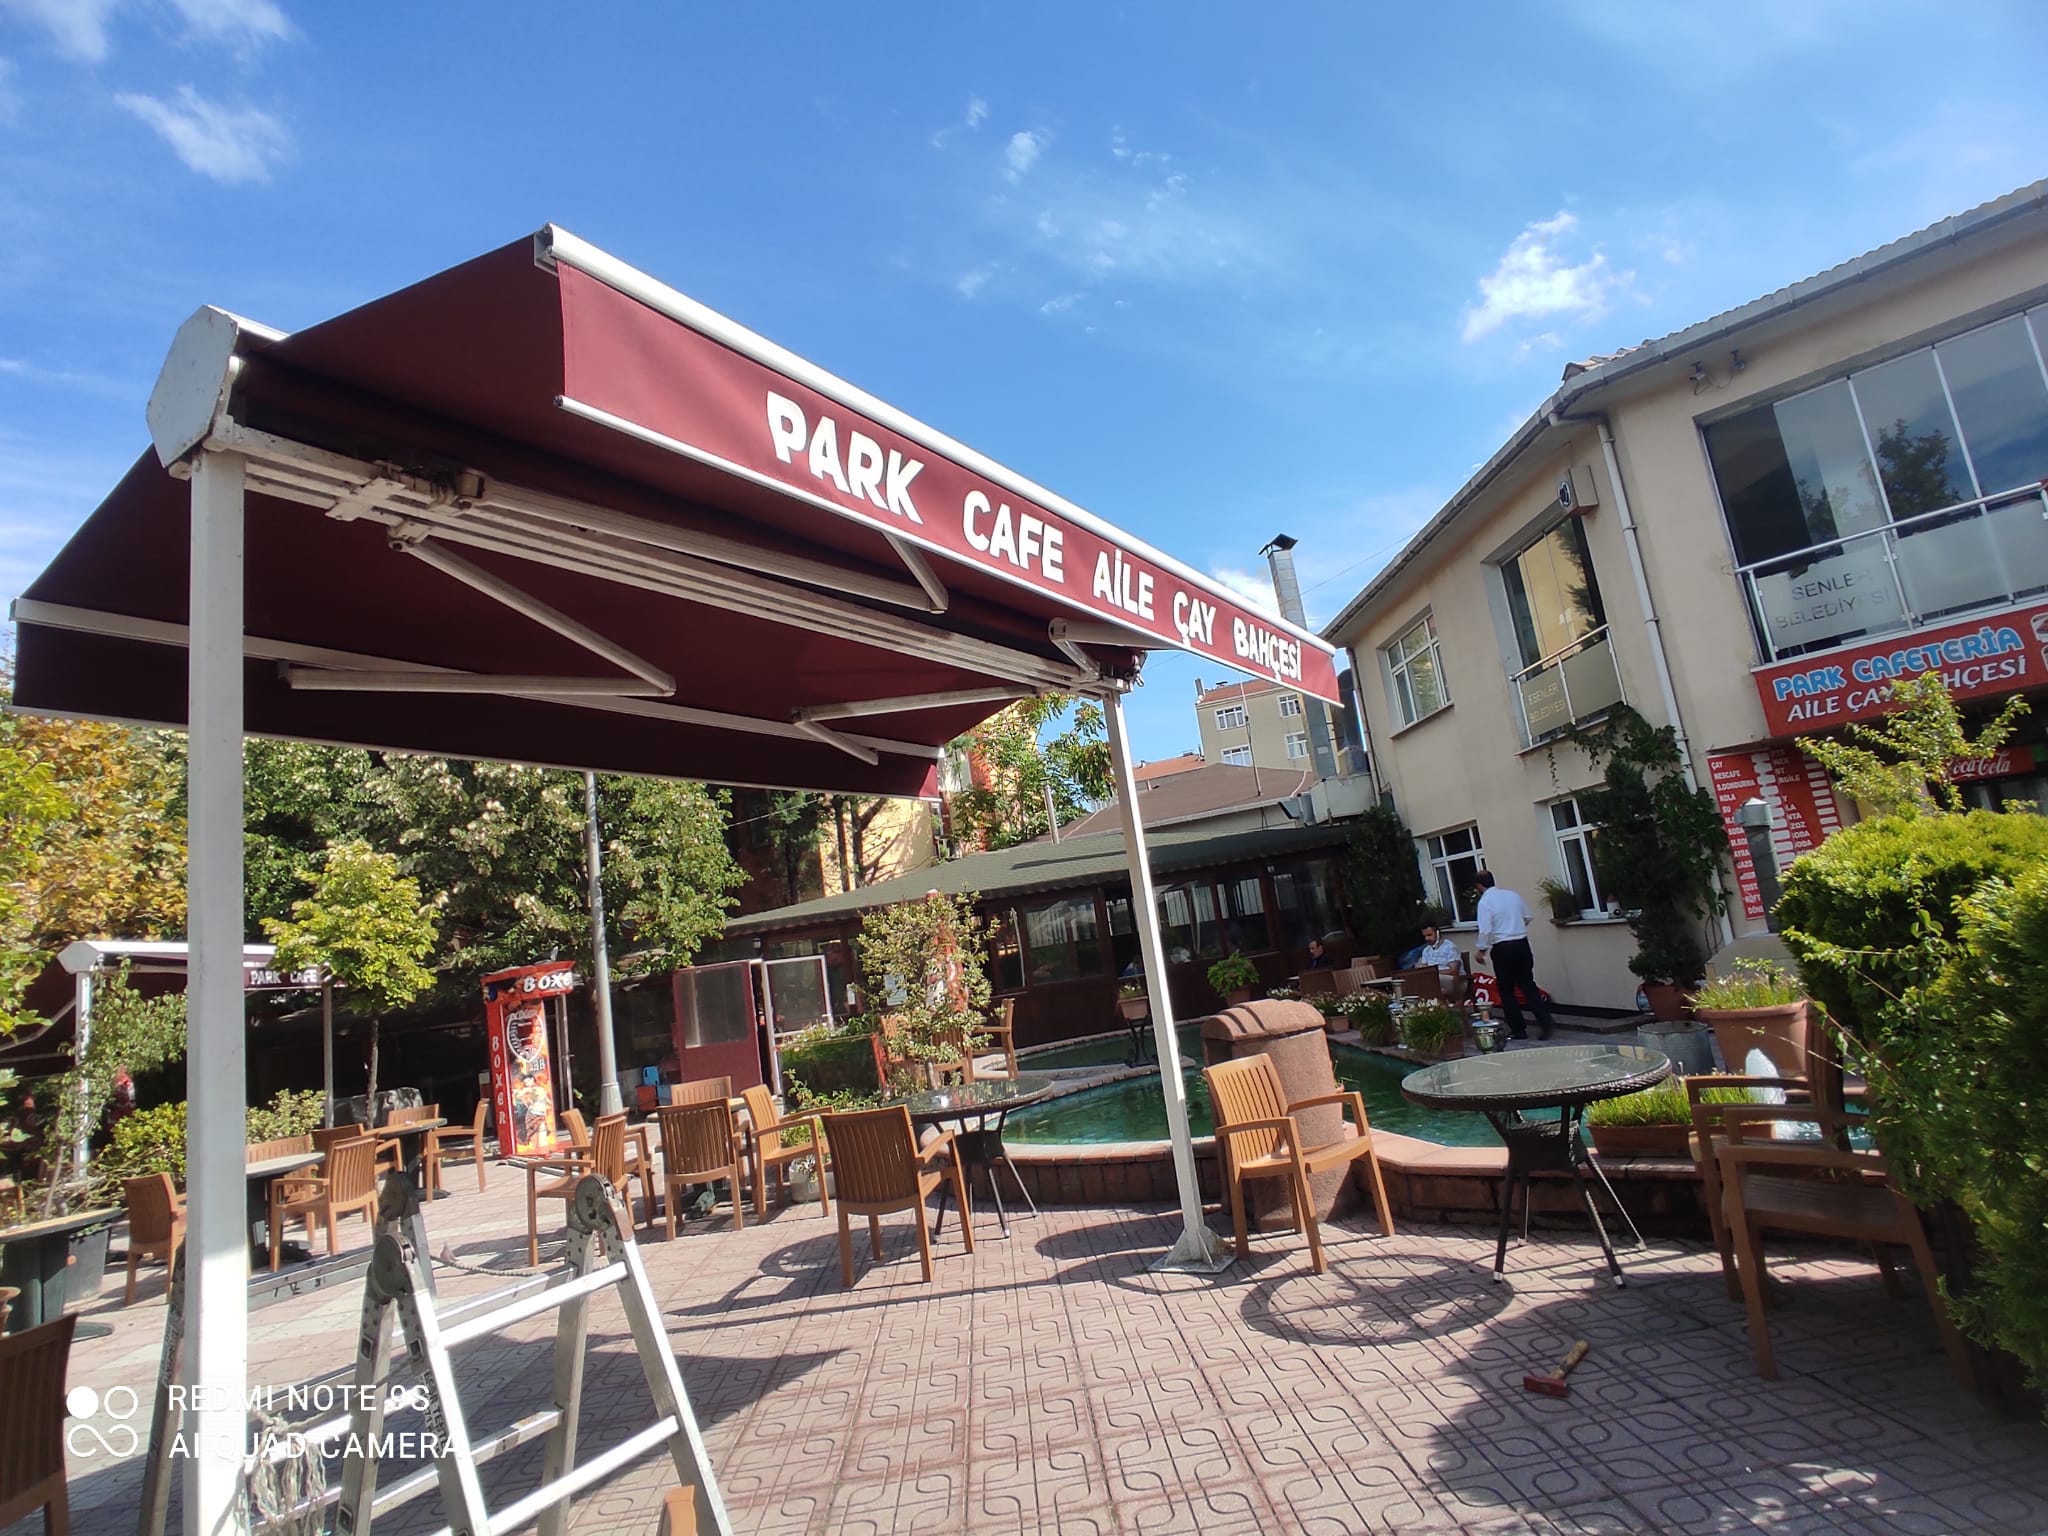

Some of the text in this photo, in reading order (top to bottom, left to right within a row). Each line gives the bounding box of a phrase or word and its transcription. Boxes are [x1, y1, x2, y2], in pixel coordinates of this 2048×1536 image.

[766, 391, 1302, 682] PARK CAFE AİLE ÇAY BAHÇESİ
[1772, 626, 2024, 701] PARK CAFETERİA
[1787, 695, 1841, 723] AİLE
[250, 969, 317, 985] PARK CAFE
